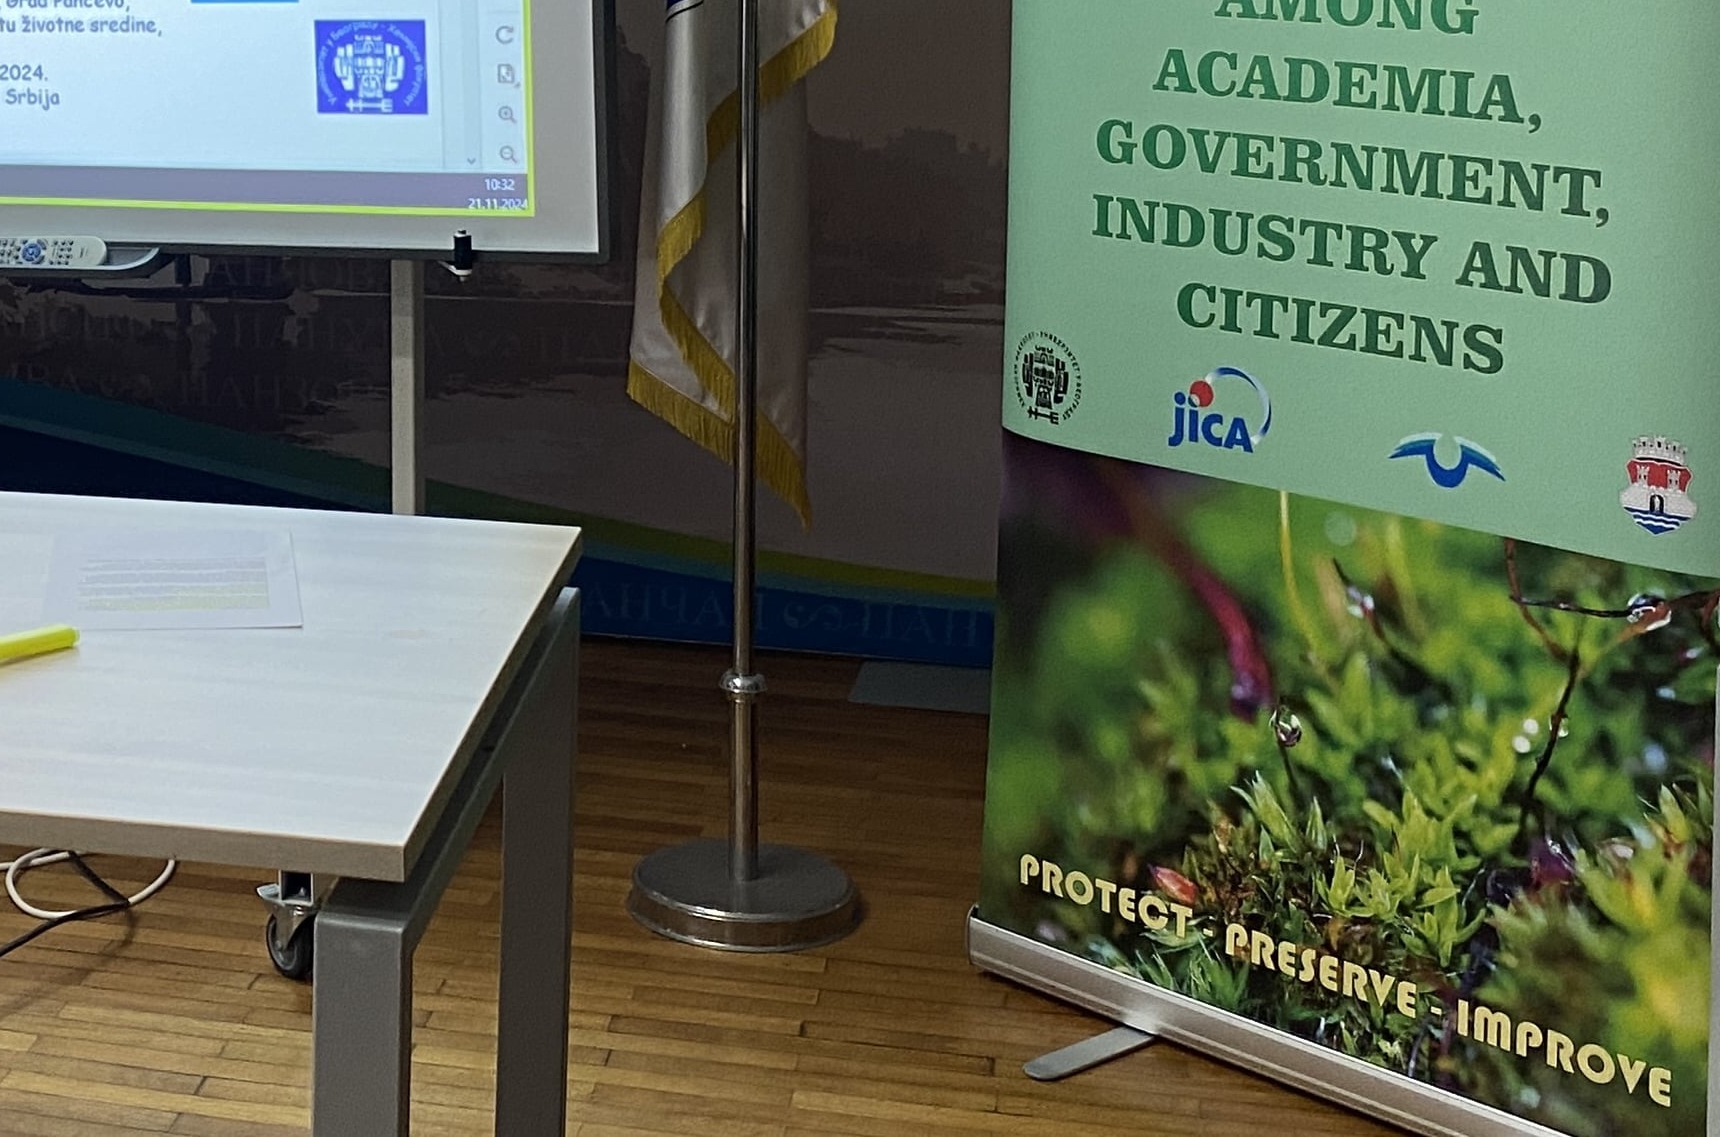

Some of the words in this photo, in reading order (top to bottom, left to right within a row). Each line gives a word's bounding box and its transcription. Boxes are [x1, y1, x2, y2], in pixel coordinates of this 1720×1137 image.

[22, 14, 85, 33] životne
[89, 16, 163, 37] sredine,
[5, 88, 60, 111] Srbija
[1153, 48, 1542, 134] ACADEMIA,
[484, 178, 515, 191] 10:32
[1095, 118, 1610, 229] GOVERNMENT,
[1091, 193, 1439, 280] INDUSTRY
[1455, 241, 1613, 305] AND
[1176, 282, 1505, 375] CITIZENS
[1018, 853, 1193, 939] PROTECT
[1225, 923, 1418, 1019] PRESERVE
[1457, 999, 1672, 1108] IMPROVE
